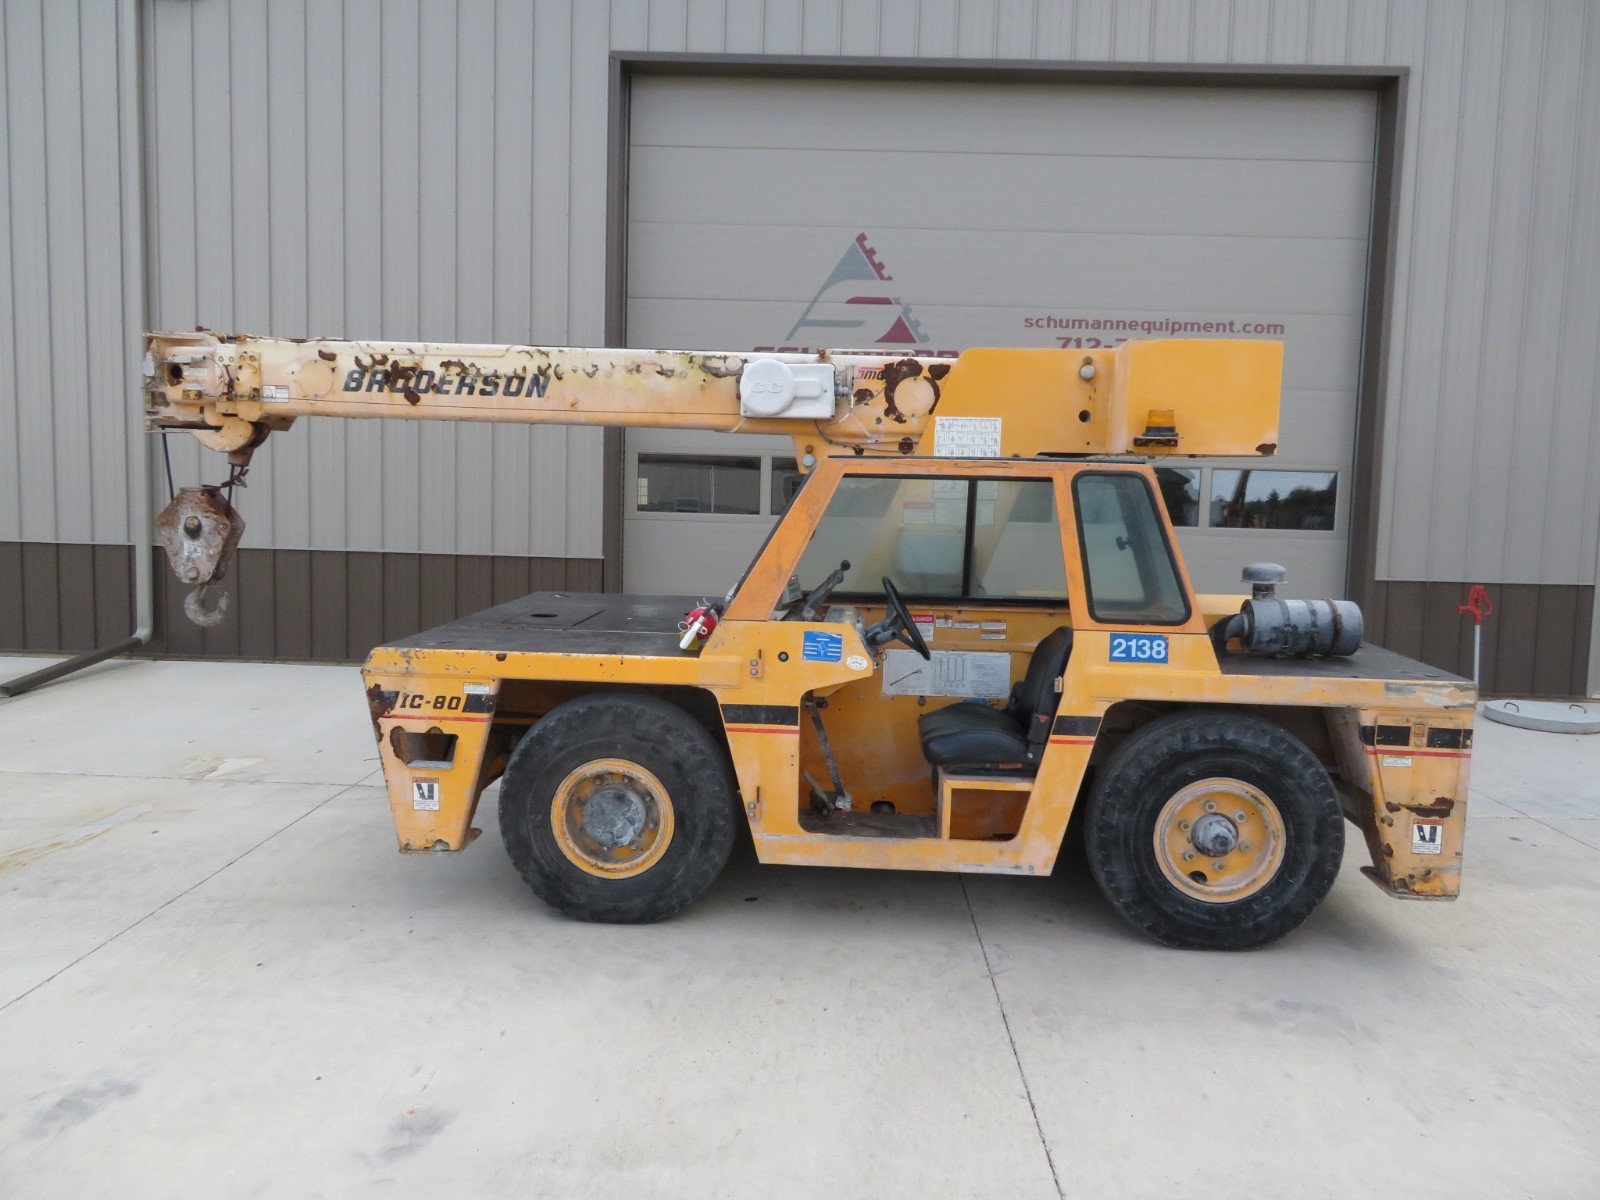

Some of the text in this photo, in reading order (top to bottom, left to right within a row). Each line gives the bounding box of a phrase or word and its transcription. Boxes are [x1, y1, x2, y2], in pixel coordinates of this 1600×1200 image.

[1024, 315, 1285, 335] schumannequipment.com
[342, 369, 550, 398] BRODERSON
[1112, 638, 1166, 659] 2138
[400, 694, 461, 711] IC-80
